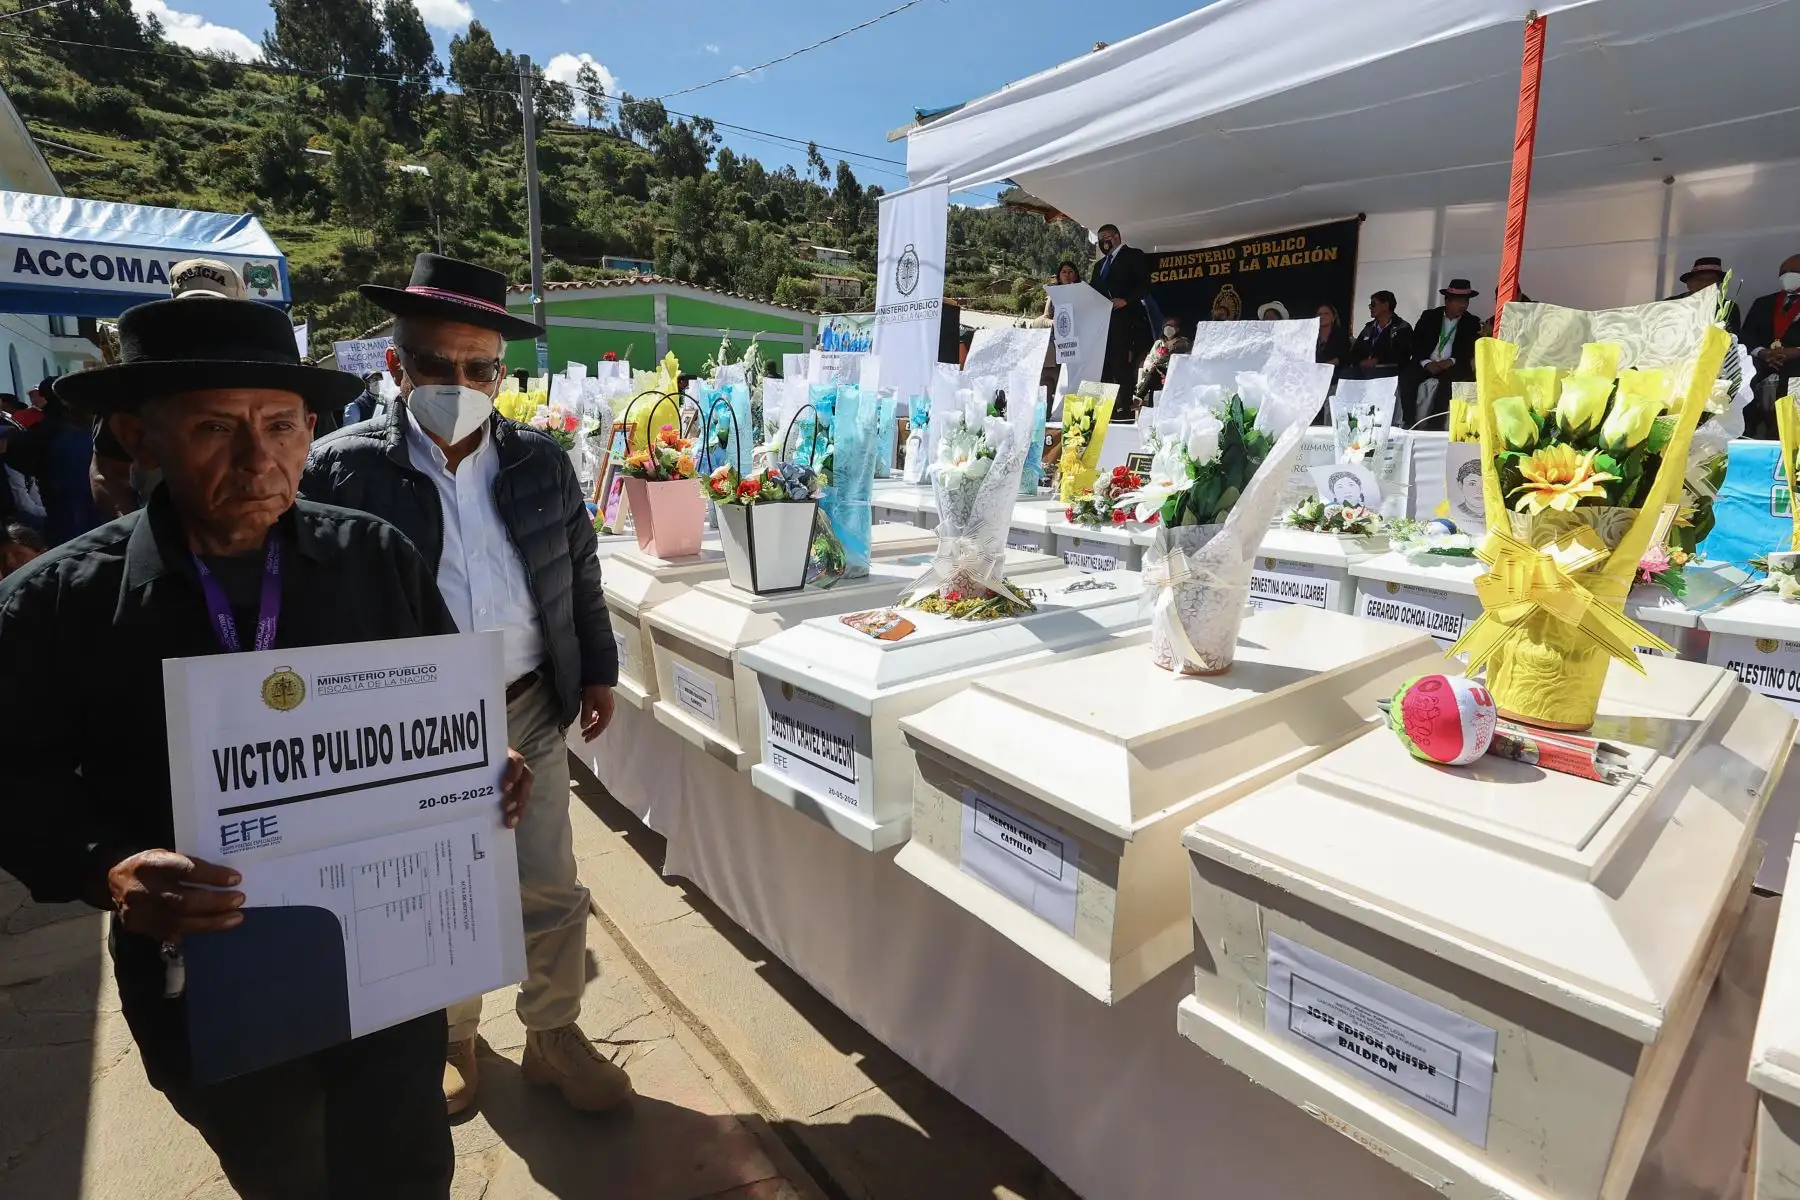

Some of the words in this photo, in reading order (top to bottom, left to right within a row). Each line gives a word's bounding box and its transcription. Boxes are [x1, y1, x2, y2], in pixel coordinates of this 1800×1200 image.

[13, 247, 178, 285] ACCOMA
[1159, 248, 1235, 268] MINISTERIO
[1209, 262, 1231, 276] DE
[1239, 257, 1261, 272] LA
[1267, 246, 1338, 269] NACIÓN
[176, 266, 226, 287] POLICIA
[1250, 577, 1279, 594] ERNESTINA
[1281, 581, 1299, 598] OCHOA
[1301, 584, 1325, 602] LIZARBE
[1367, 600, 1399, 621] GERARDO
[1401, 606, 1425, 627] OCHOA
[1427, 611, 1460, 634] LIZARBE
[317, 671, 386, 686] MINISTERIO
[389, 665, 437, 678] PÚBLICO
[367, 680, 381, 690] DE
[385, 678, 397, 687] LA
[212, 737, 307, 792] VICTOR
[312, 723, 393, 776] PULIDO
[400, 711, 479, 761] LOZANO
[773, 752, 788, 769] EFE
[796, 720, 821, 756] CHAVEZ
[821, 727, 853, 771] BALDEON
[418, 785, 495, 810] 20-05-2022
[220, 814, 279, 847] EFE
[988, 813, 1018, 836] MARCIAL
[1019, 831, 1048, 850] CHAVEZ
[1000, 832, 1033, 855] CASTILLO
[1306, 1005, 1335, 1027] JOSE
[1336, 1019, 1384, 1051] EDISON
[1386, 1045, 1437, 1077] QUISPE
[1338, 1035, 1398, 1074] BALDEON
